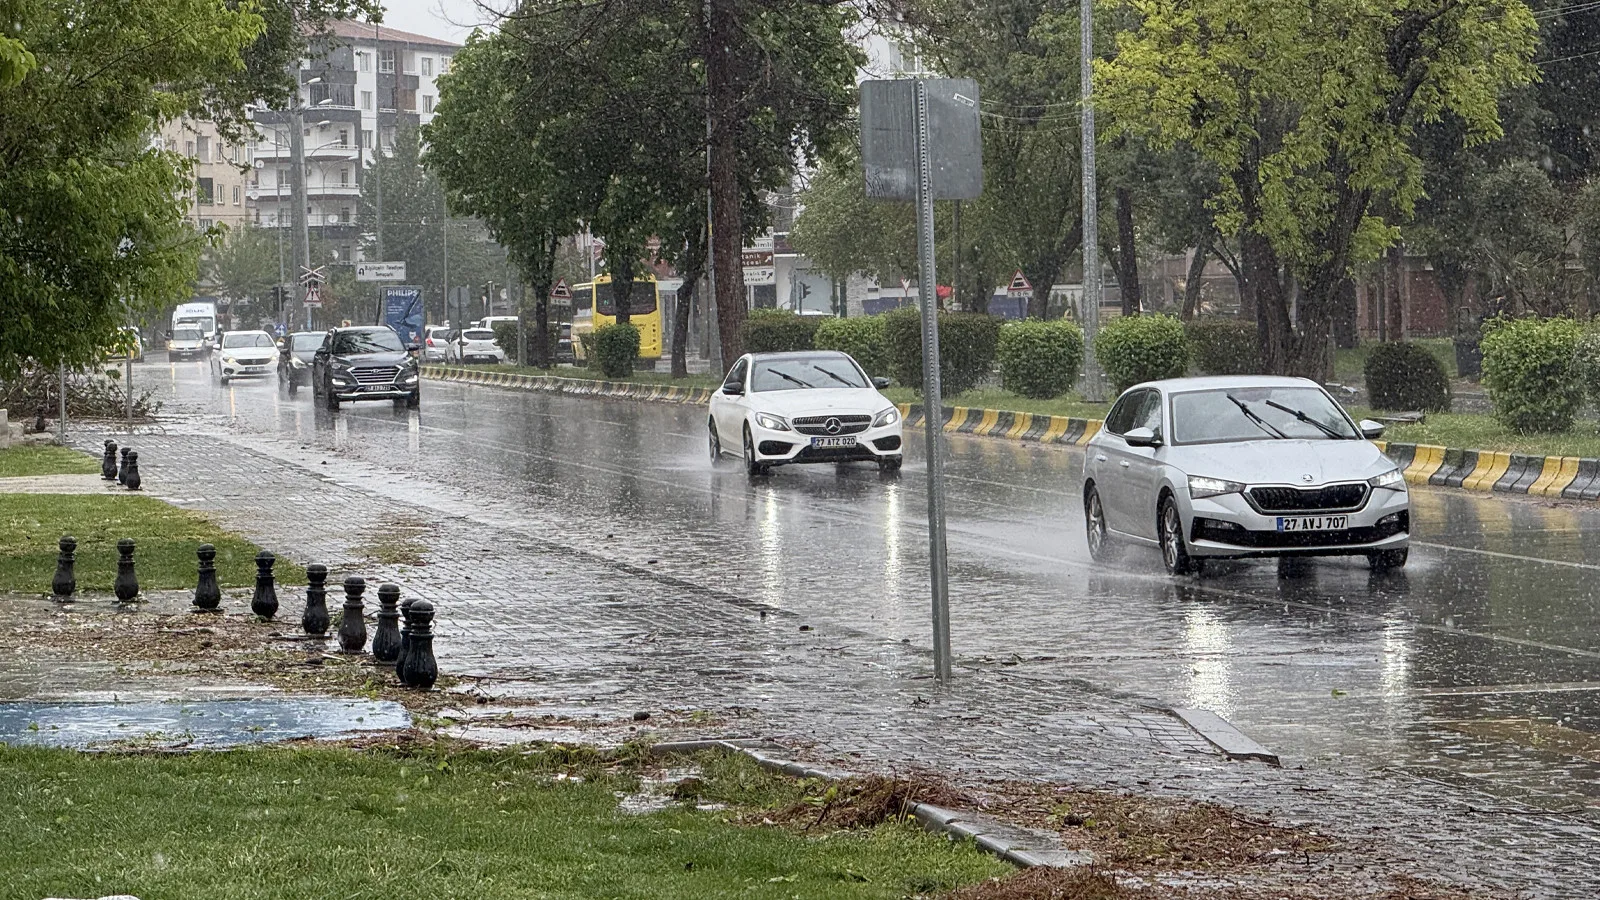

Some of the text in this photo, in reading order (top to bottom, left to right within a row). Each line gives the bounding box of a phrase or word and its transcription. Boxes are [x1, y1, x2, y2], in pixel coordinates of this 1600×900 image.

[387, 289, 417, 297] PHILIPS
[816, 437, 856, 447] 27 ATZ 020
[1284, 516, 1346, 530] 27 AVJ 707
